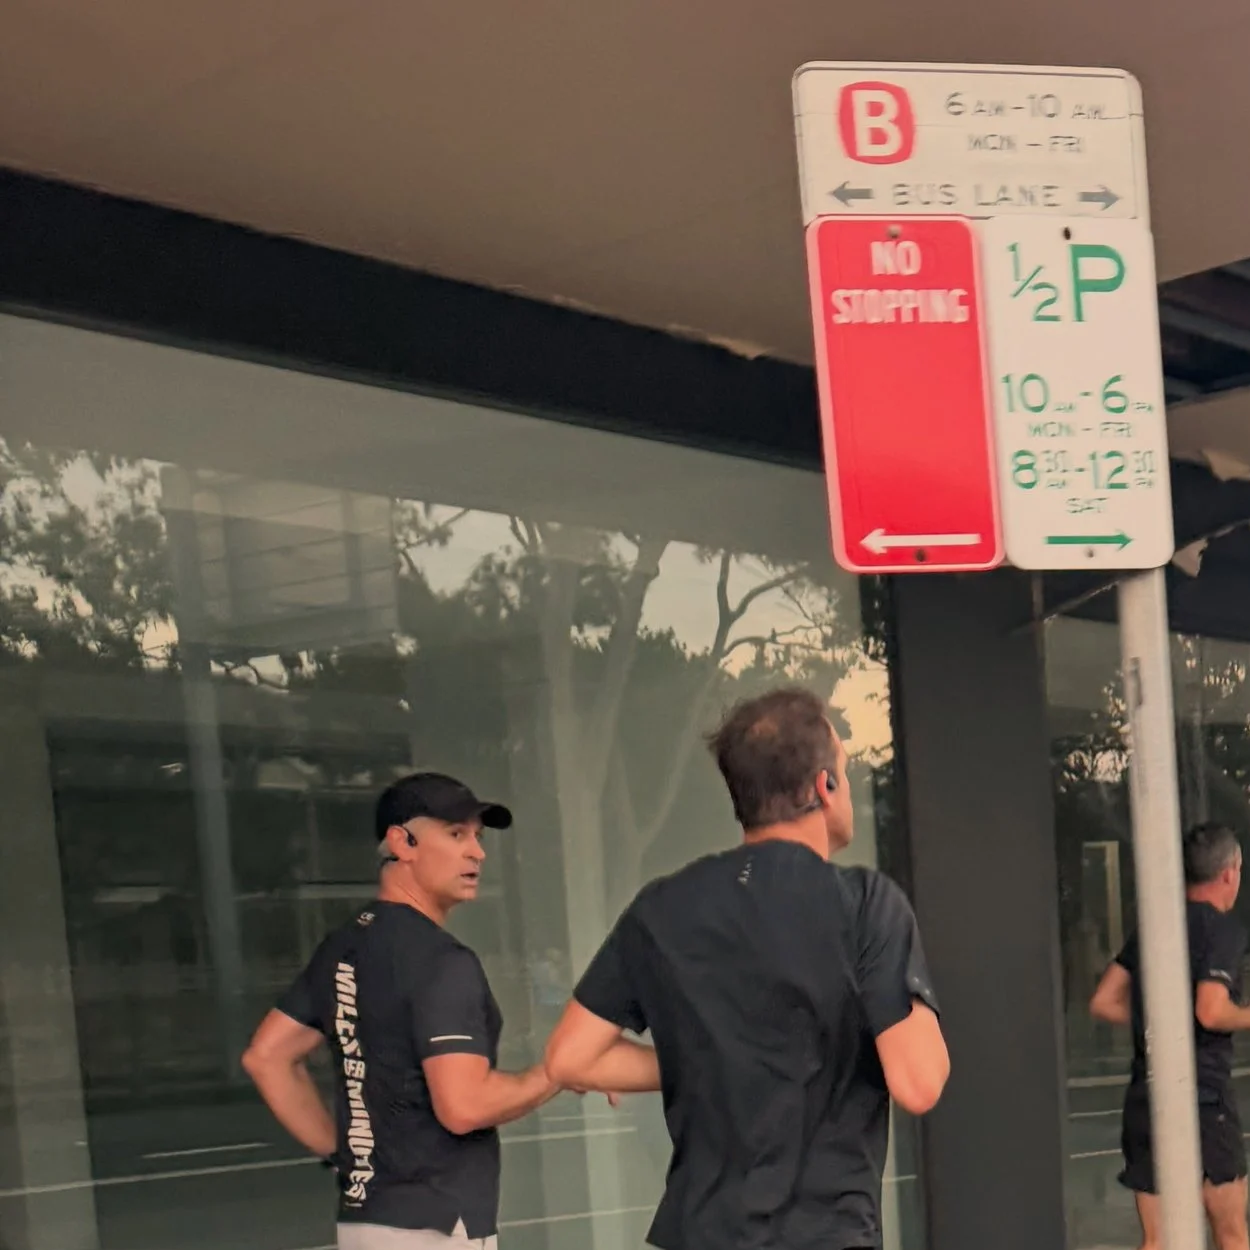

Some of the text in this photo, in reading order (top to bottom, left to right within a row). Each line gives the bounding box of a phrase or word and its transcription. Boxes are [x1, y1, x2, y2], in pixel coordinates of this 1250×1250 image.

[851, 90, 903, 157] B
[892, 184, 1062, 207] BUS LANE
[870, 241, 922, 275] NO
[831, 289, 970, 324] STOPPING
